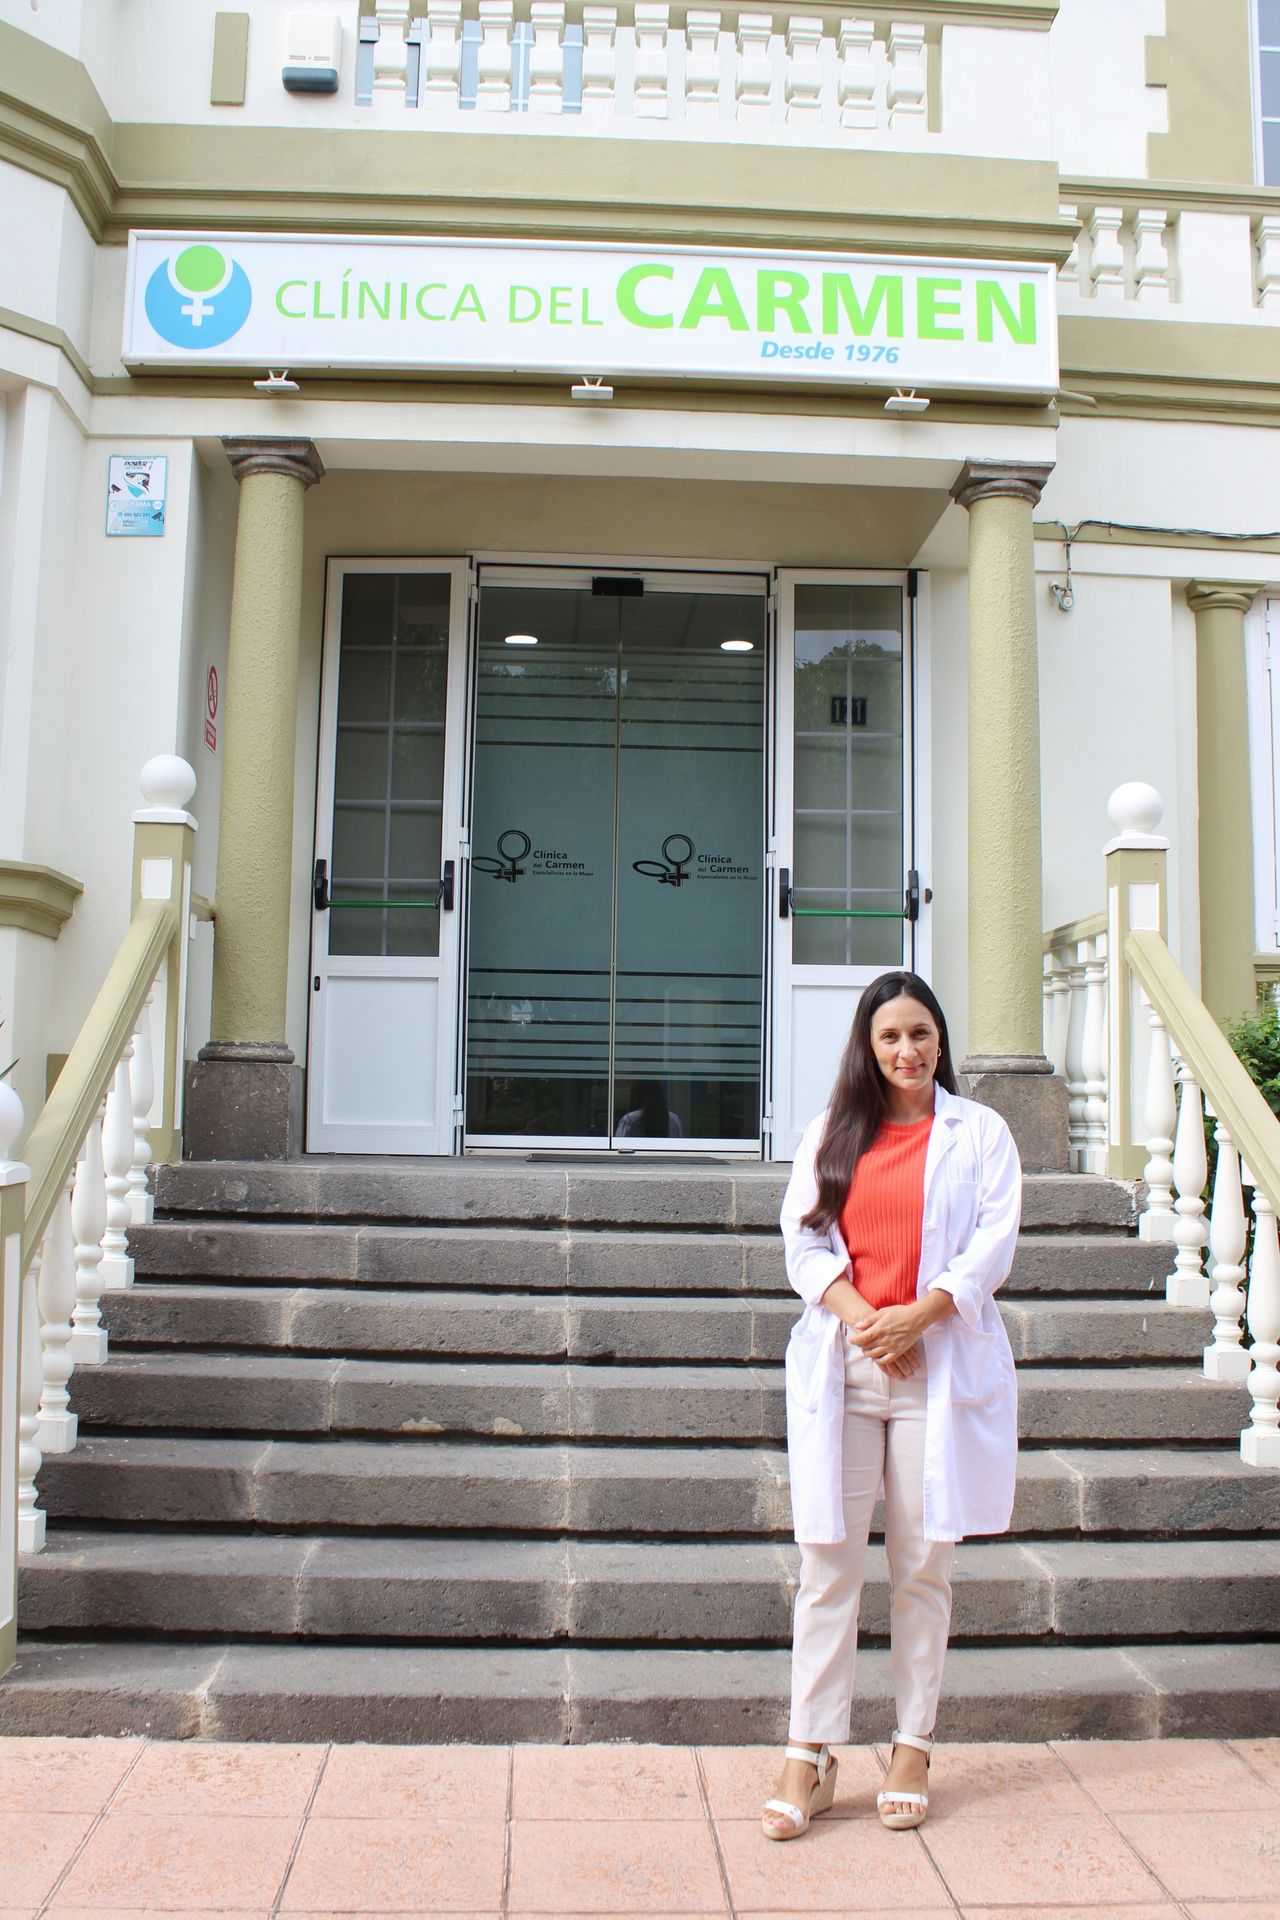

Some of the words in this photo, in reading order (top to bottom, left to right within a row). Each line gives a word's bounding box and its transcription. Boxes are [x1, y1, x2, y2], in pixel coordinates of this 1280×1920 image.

[275, 268, 487, 323] CLÍNICA
[508, 285, 604, 326] DEL
[616, 263, 1037, 345] CARMEN
[760, 340, 834, 361] Desde
[844, 343, 900, 364] 1976
[545, 860, 585, 870] Carmen
[709, 865, 749, 874] Carmen
